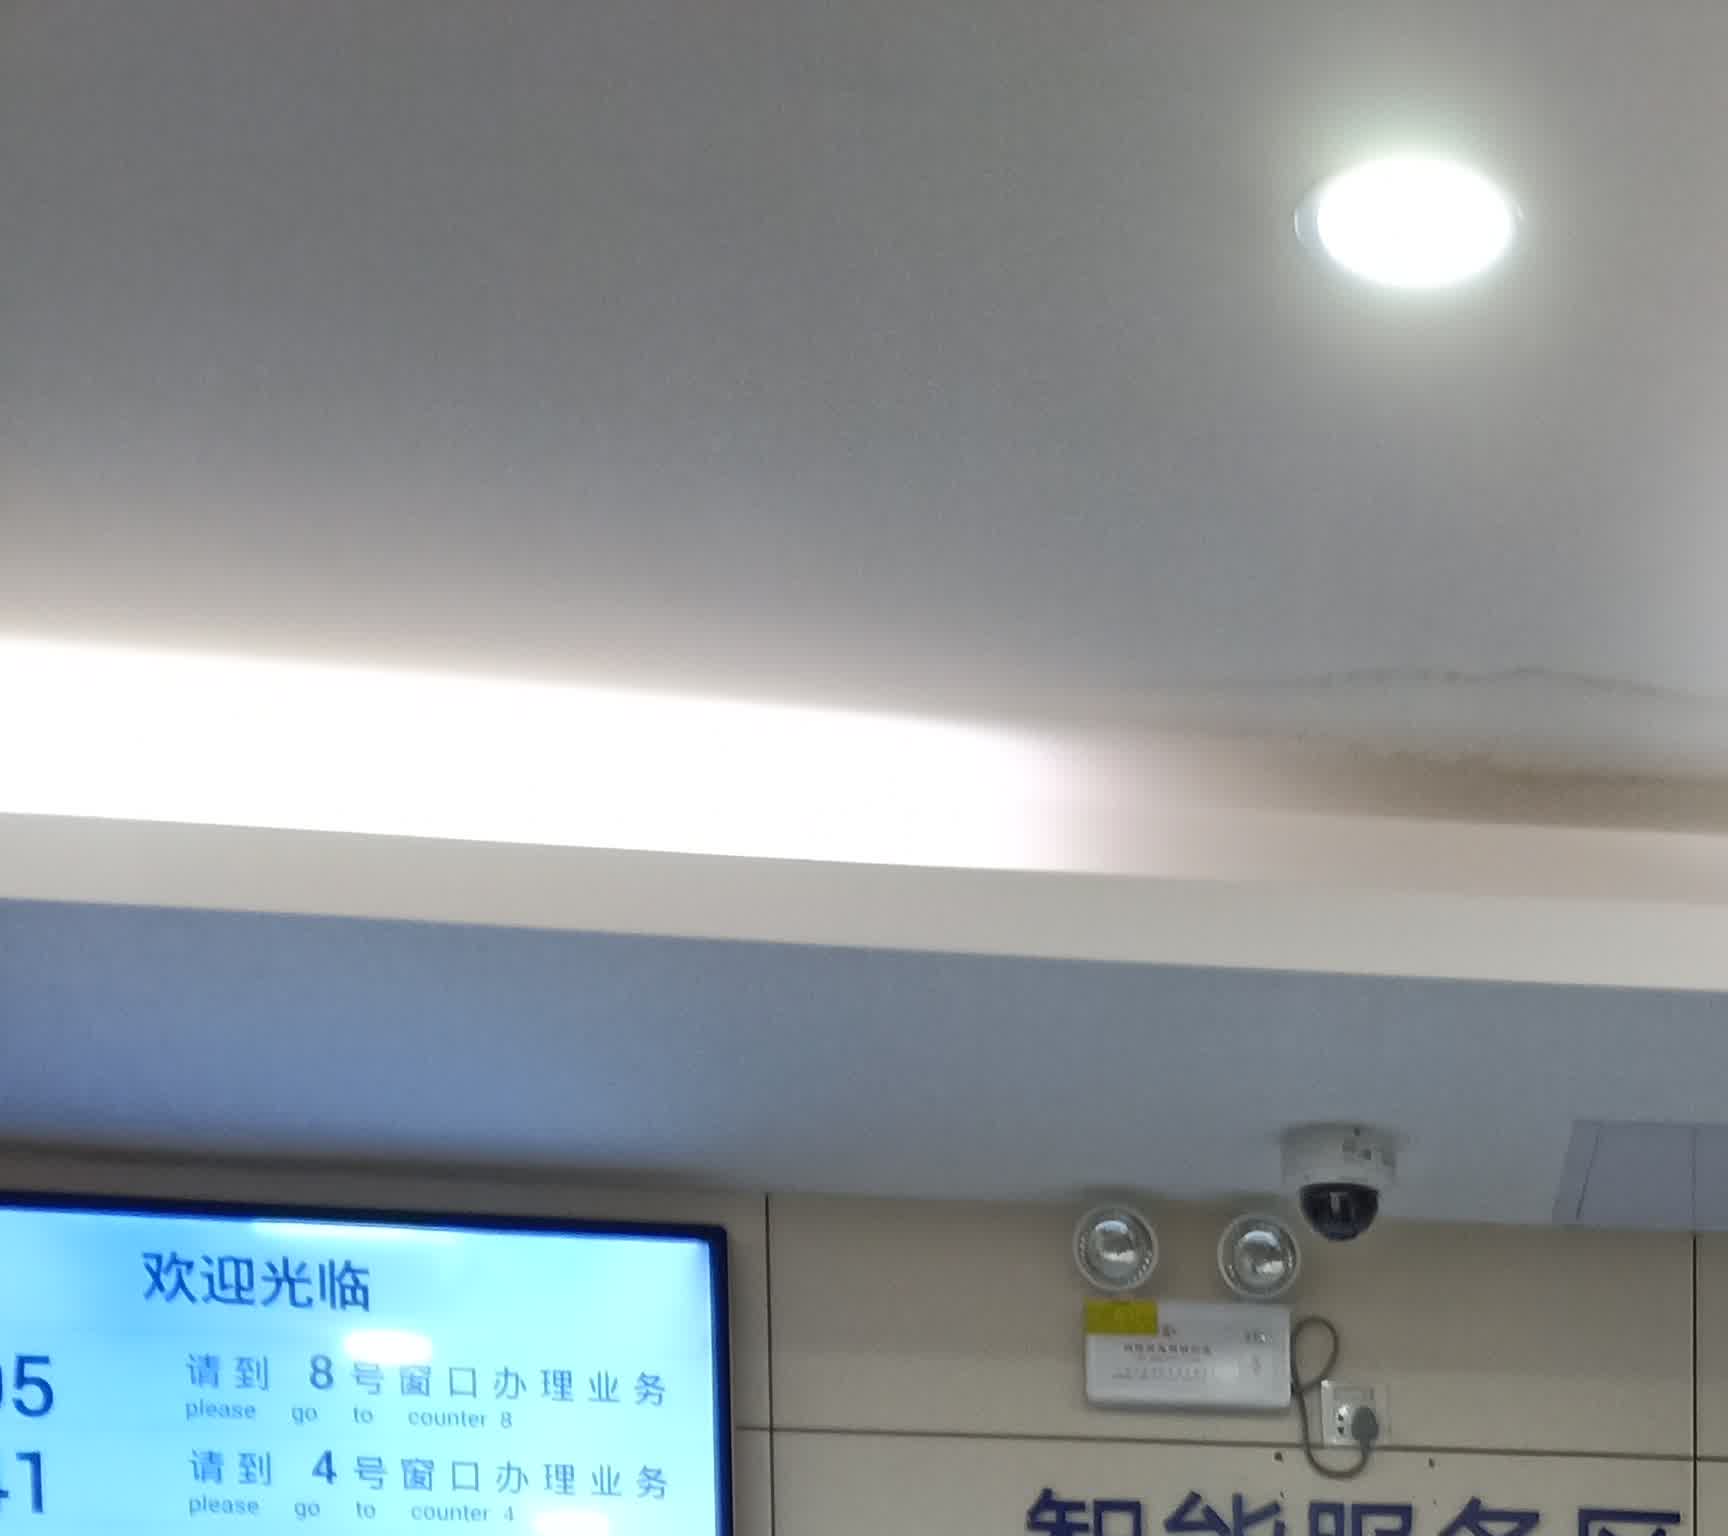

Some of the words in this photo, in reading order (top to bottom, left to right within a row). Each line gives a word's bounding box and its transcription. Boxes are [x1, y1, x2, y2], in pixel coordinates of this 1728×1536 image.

[142, 1249, 371, 1312] 欢迎光临
[0, 1353, 54, 1418] 5
[186, 1400, 257, 1421] please
[291, 1405, 318, 1426] go
[353, 1405, 374, 1424] to
[408, 1409, 487, 1429] counter
[500, 1411, 512, 1429] 8
[0, 1451, 44, 1514] 1
[189, 1496, 260, 1517] please
[294, 1501, 320, 1521] go
[356, 1501, 376, 1519] to
[411, 1504, 489, 1522] counter
[504, 1506, 514, 1522] 4
